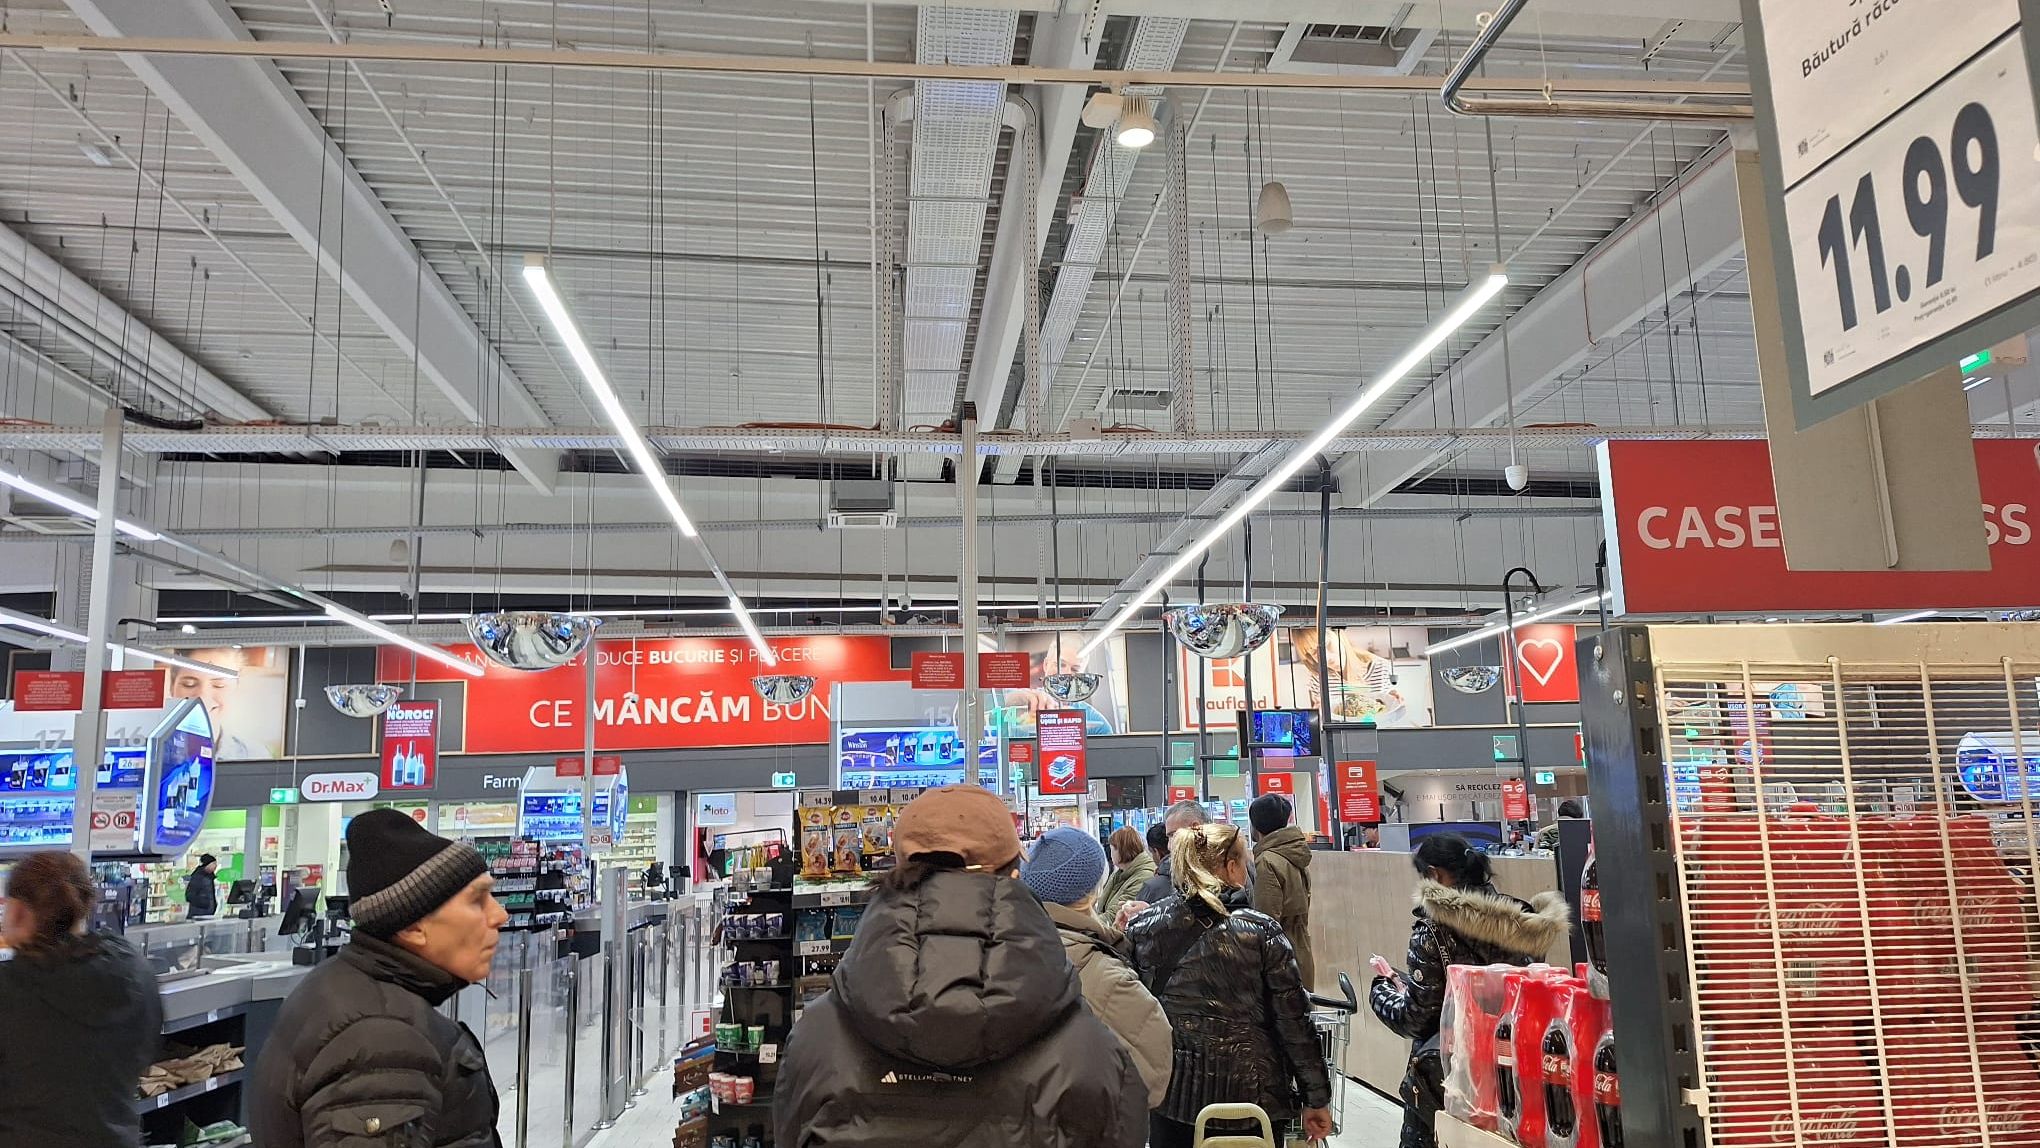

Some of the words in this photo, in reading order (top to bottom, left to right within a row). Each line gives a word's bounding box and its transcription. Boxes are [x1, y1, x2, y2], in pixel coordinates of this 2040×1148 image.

[1801, 17, 1862, 78] Băutură
[1818, 102, 1999, 332] 11.99
[1637, 505, 1781, 550] CASE
[649, 650, 724, 664] BUCURIE
[528, 699, 573, 728] CE
[593, 690, 751, 727] MÂNCĂM
[924, 706, 952, 728] 15
[35, 730, 66, 751] 17
[115, 726, 146, 747] 16
[122, 759, 133, 768] 26
[311, 780, 366, 794] Dr.Max
[483, 775, 522, 790] Farm
[814, 797, 832, 806] 14.39
[870, 795, 887, 803] 10.49
[711, 806, 729, 816] loto
[811, 944, 830, 953] 27.99
